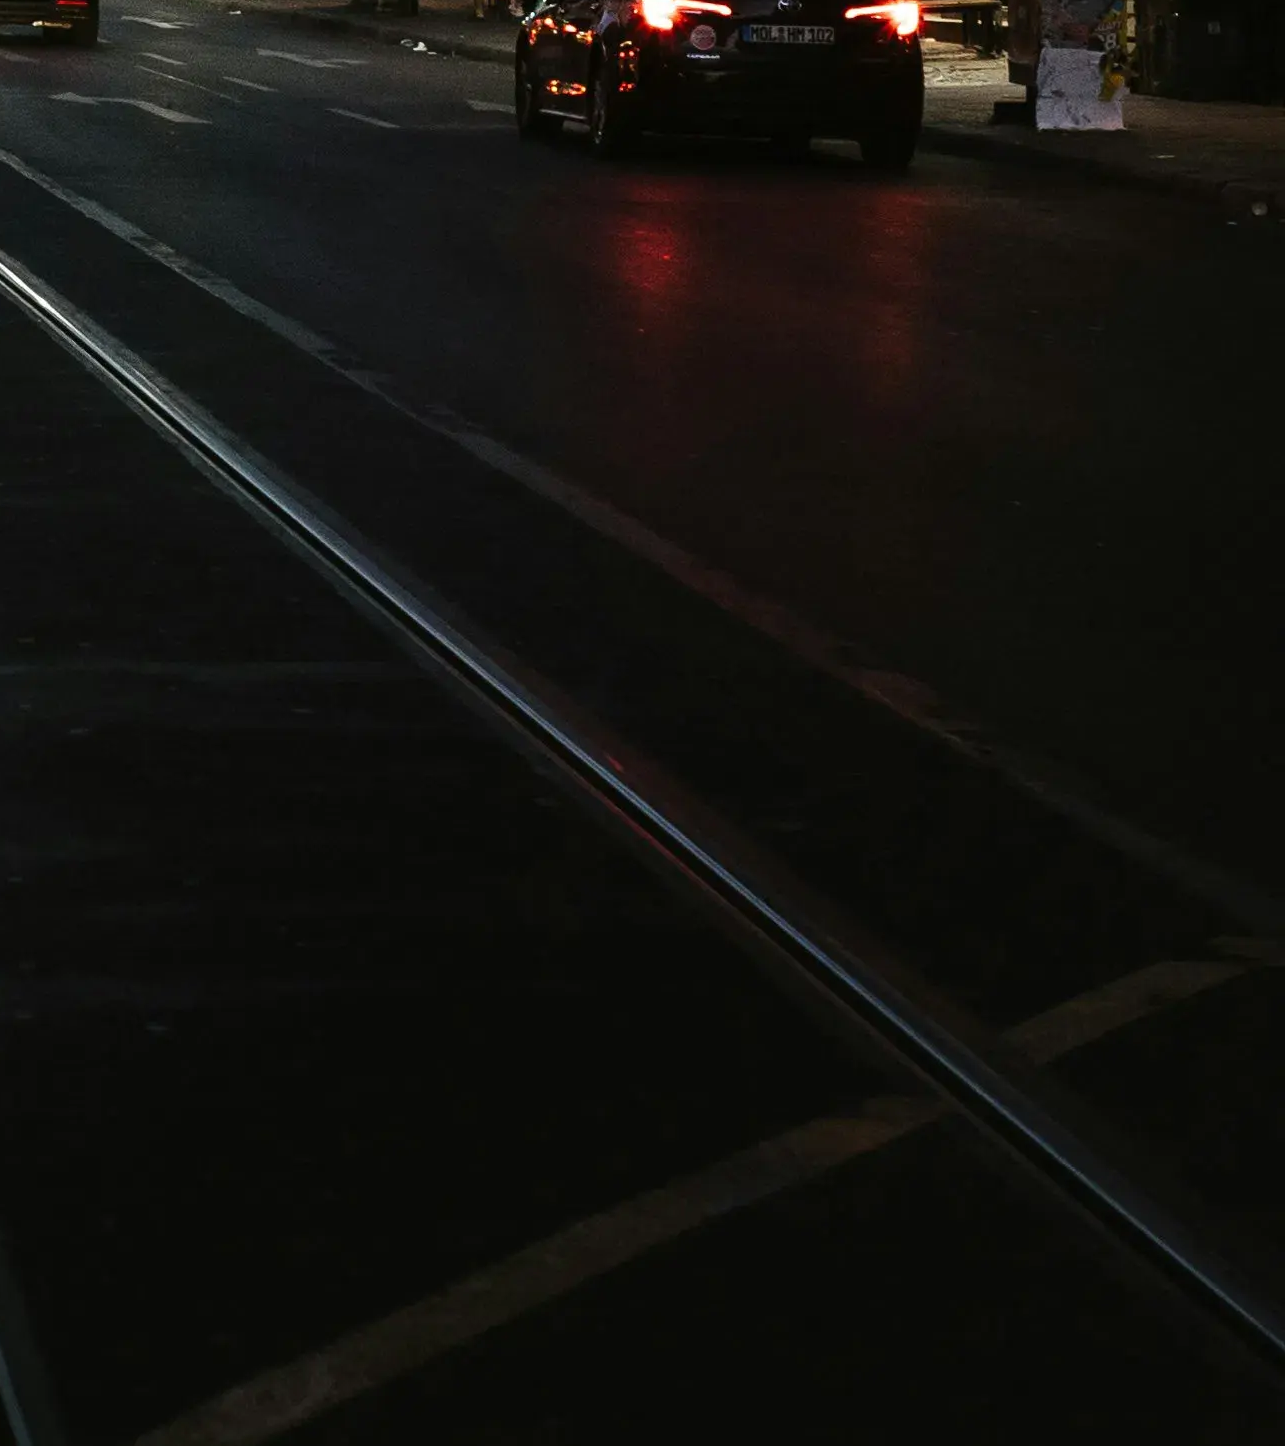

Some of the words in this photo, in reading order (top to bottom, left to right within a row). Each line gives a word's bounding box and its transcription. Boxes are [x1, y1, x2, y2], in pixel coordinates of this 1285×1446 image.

[750, 25, 776, 42] MOL
[788, 26, 806, 42] HM
[810, 27, 833, 43] 102
